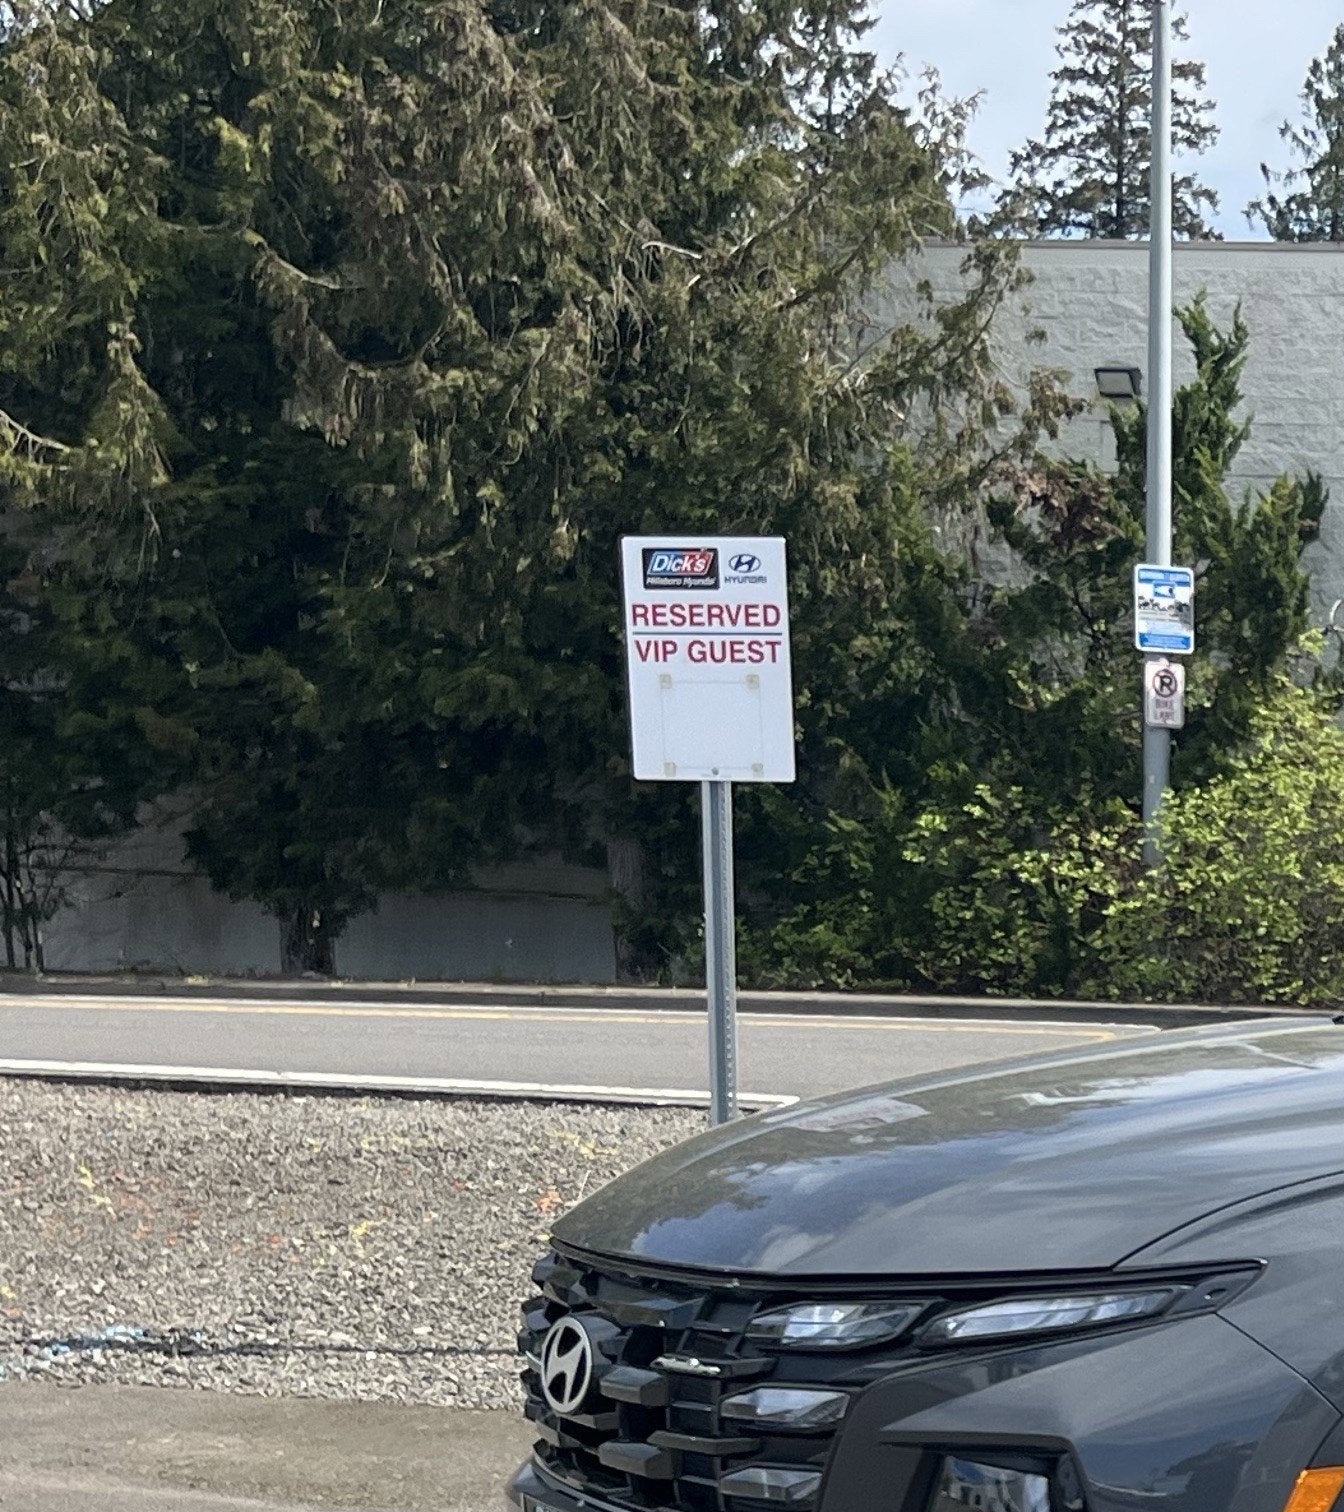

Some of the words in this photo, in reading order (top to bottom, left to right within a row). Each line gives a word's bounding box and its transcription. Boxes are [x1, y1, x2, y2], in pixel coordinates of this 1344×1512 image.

[652, 552, 708, 573] Dick's
[724, 576, 767, 584] HYUNDAI
[632, 604, 781, 627] RESERVED
[634, 640, 677, 662] VIP
[688, 640, 782, 664] GUEST
